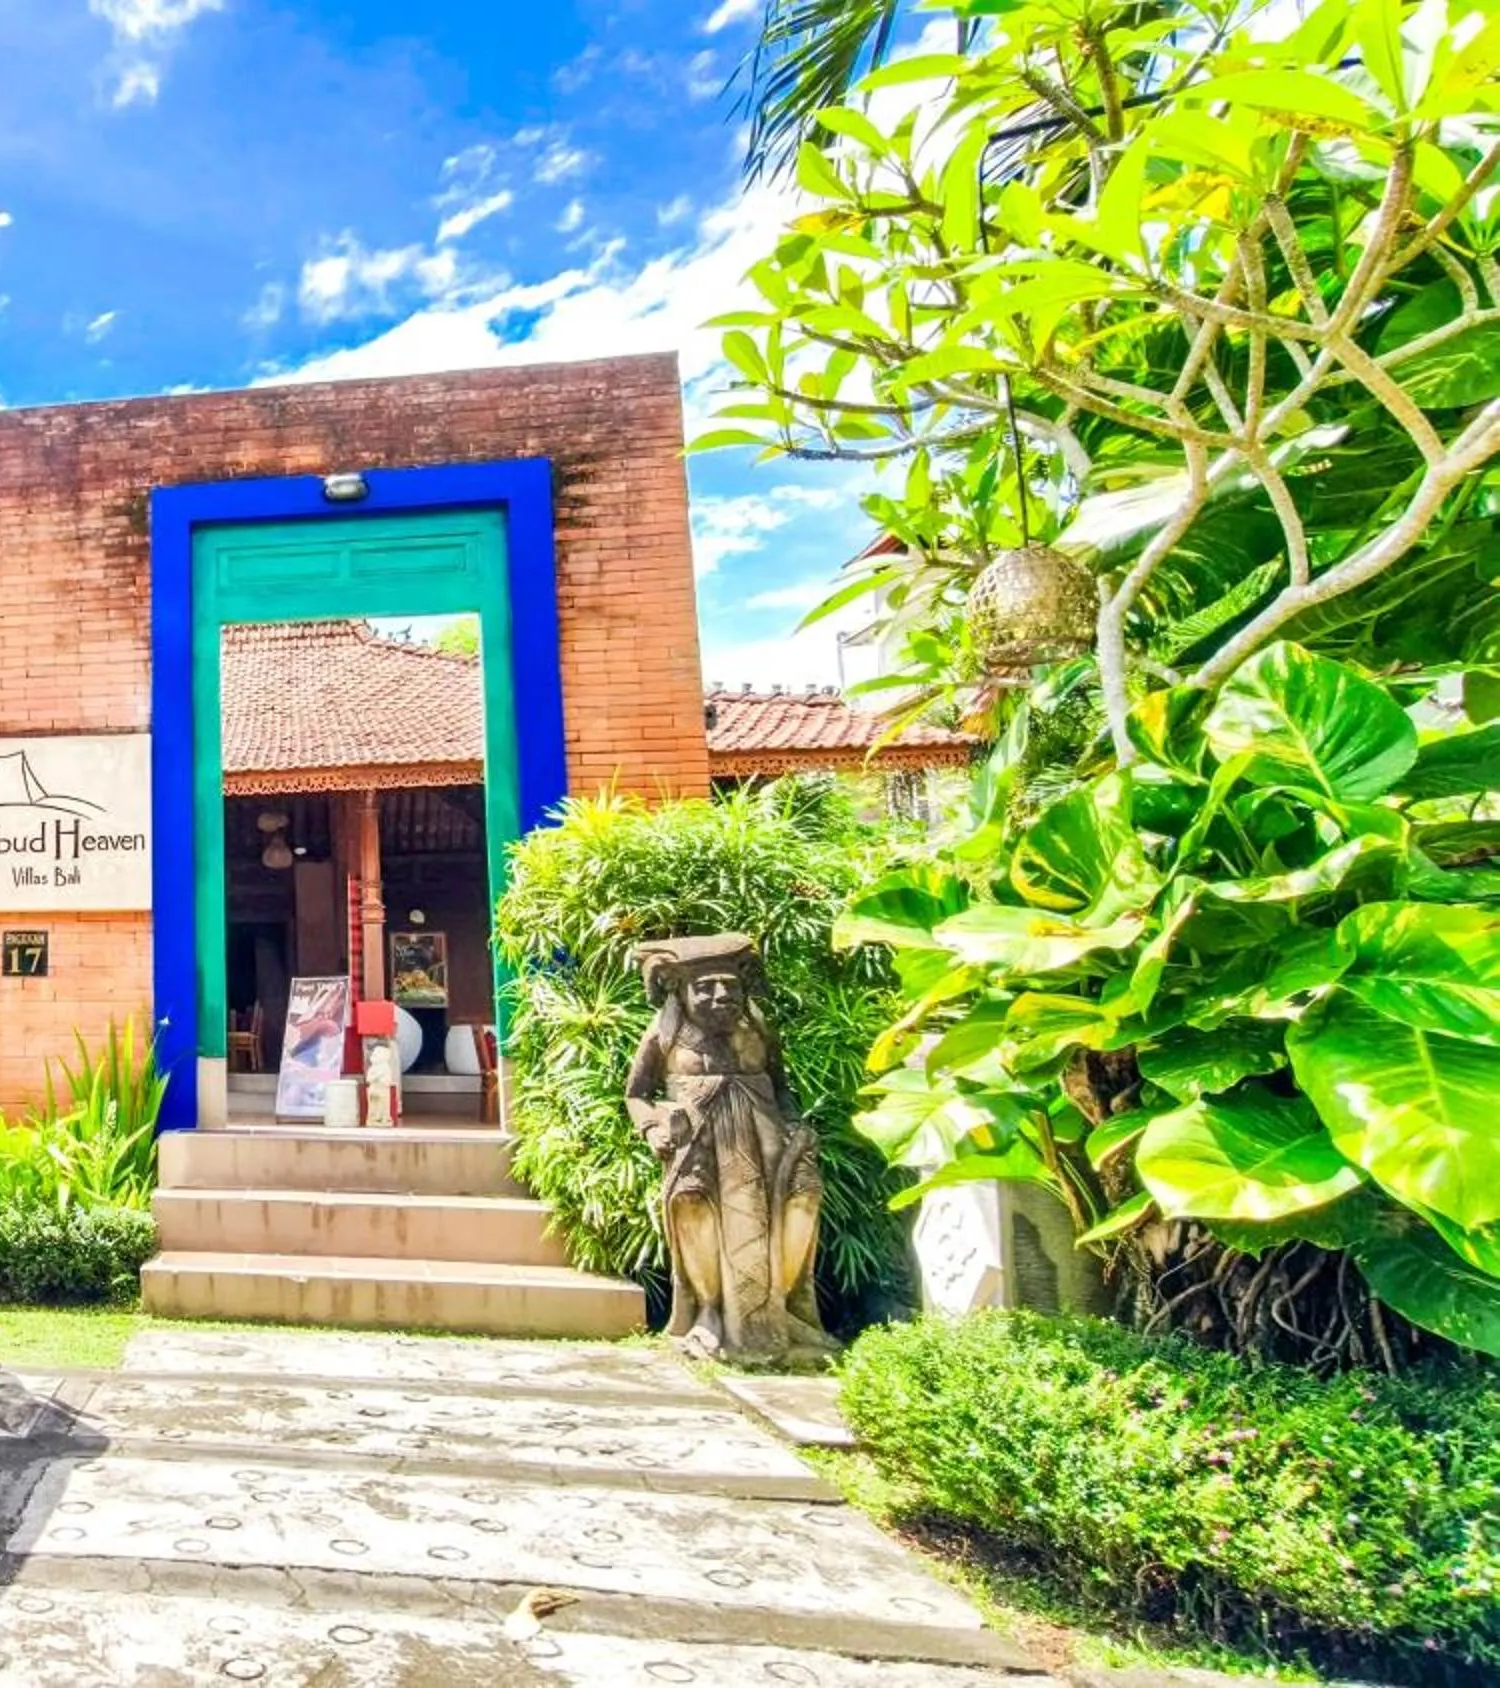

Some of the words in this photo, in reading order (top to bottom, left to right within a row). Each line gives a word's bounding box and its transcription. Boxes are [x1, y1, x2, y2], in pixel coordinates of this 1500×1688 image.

[54, 818, 146, 861] Heaven
[11, 866, 49, 888] Villas
[54, 865, 82, 888] Bali
[8, 946, 43, 974] 17
